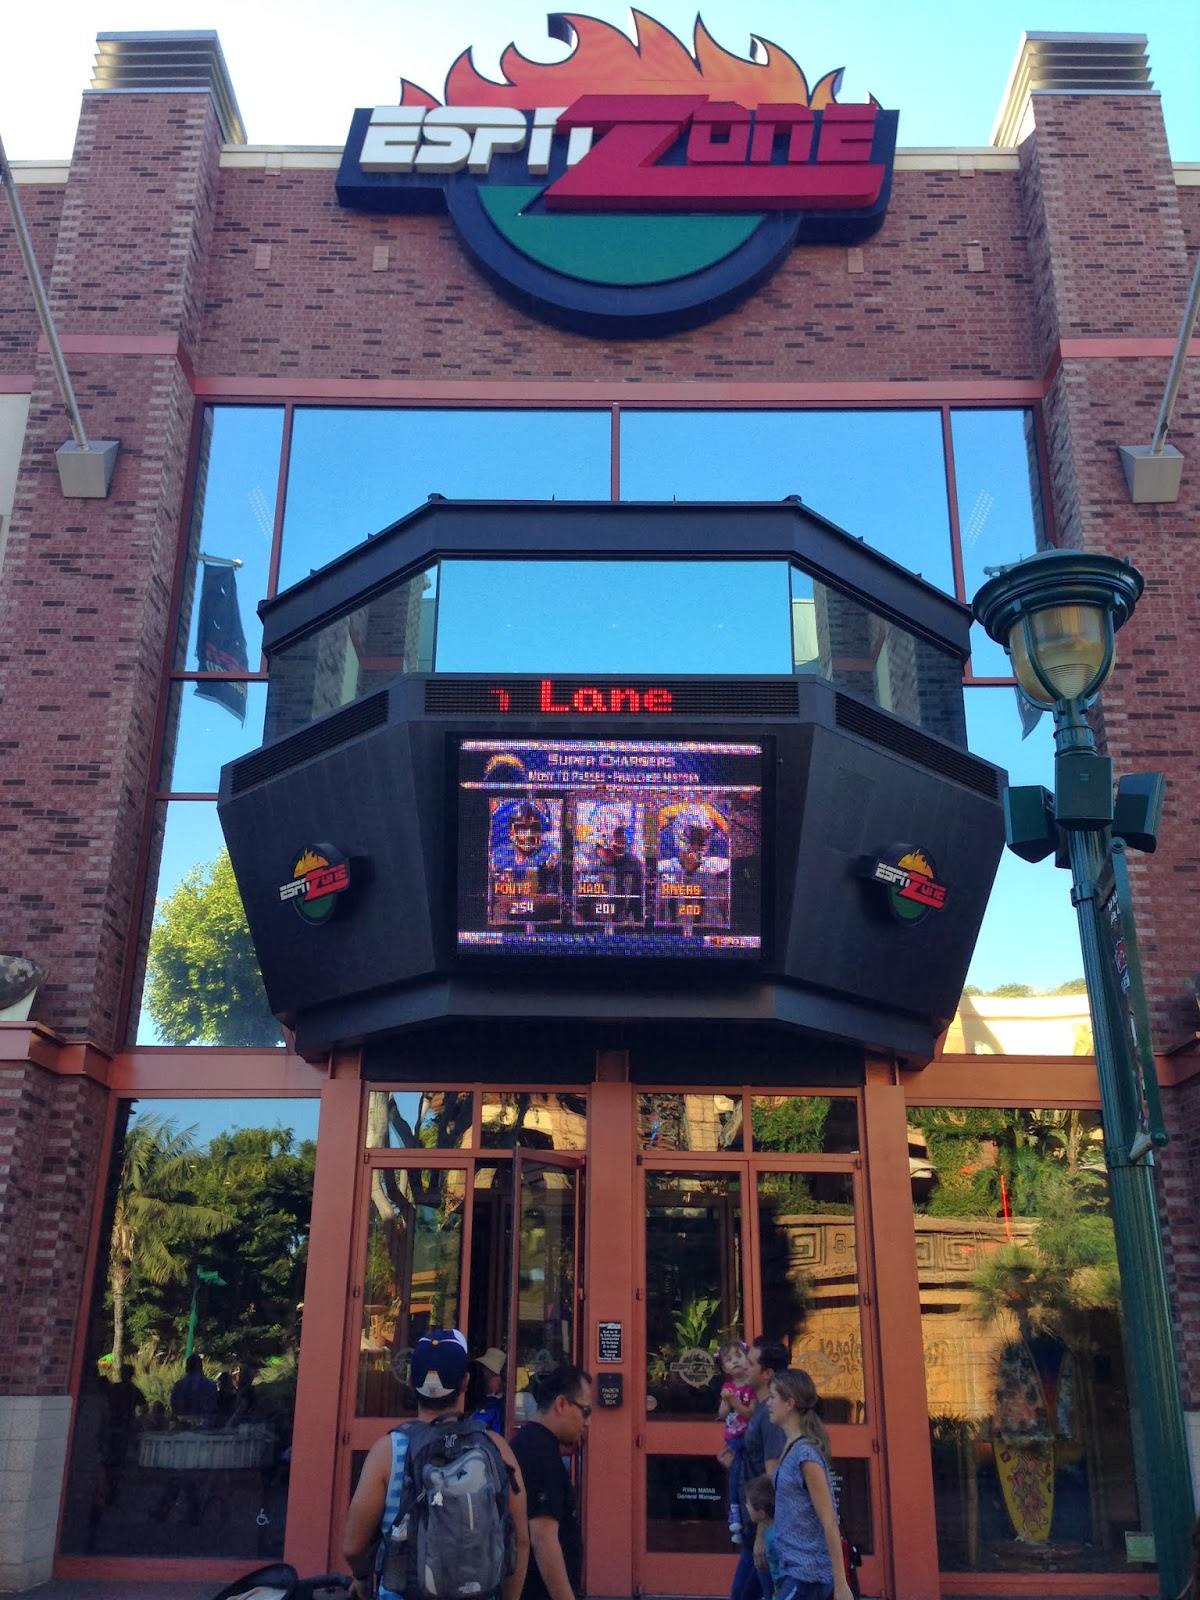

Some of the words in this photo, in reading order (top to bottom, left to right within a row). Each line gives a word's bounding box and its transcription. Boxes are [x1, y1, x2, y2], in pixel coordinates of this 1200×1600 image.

[359, 105, 594, 174] ESPN
[540, 678, 673, 712] Lane
[874, 862, 912, 888] ESPN
[279, 878, 311, 901] ESPN
[595, 903, 616, 914] 201
